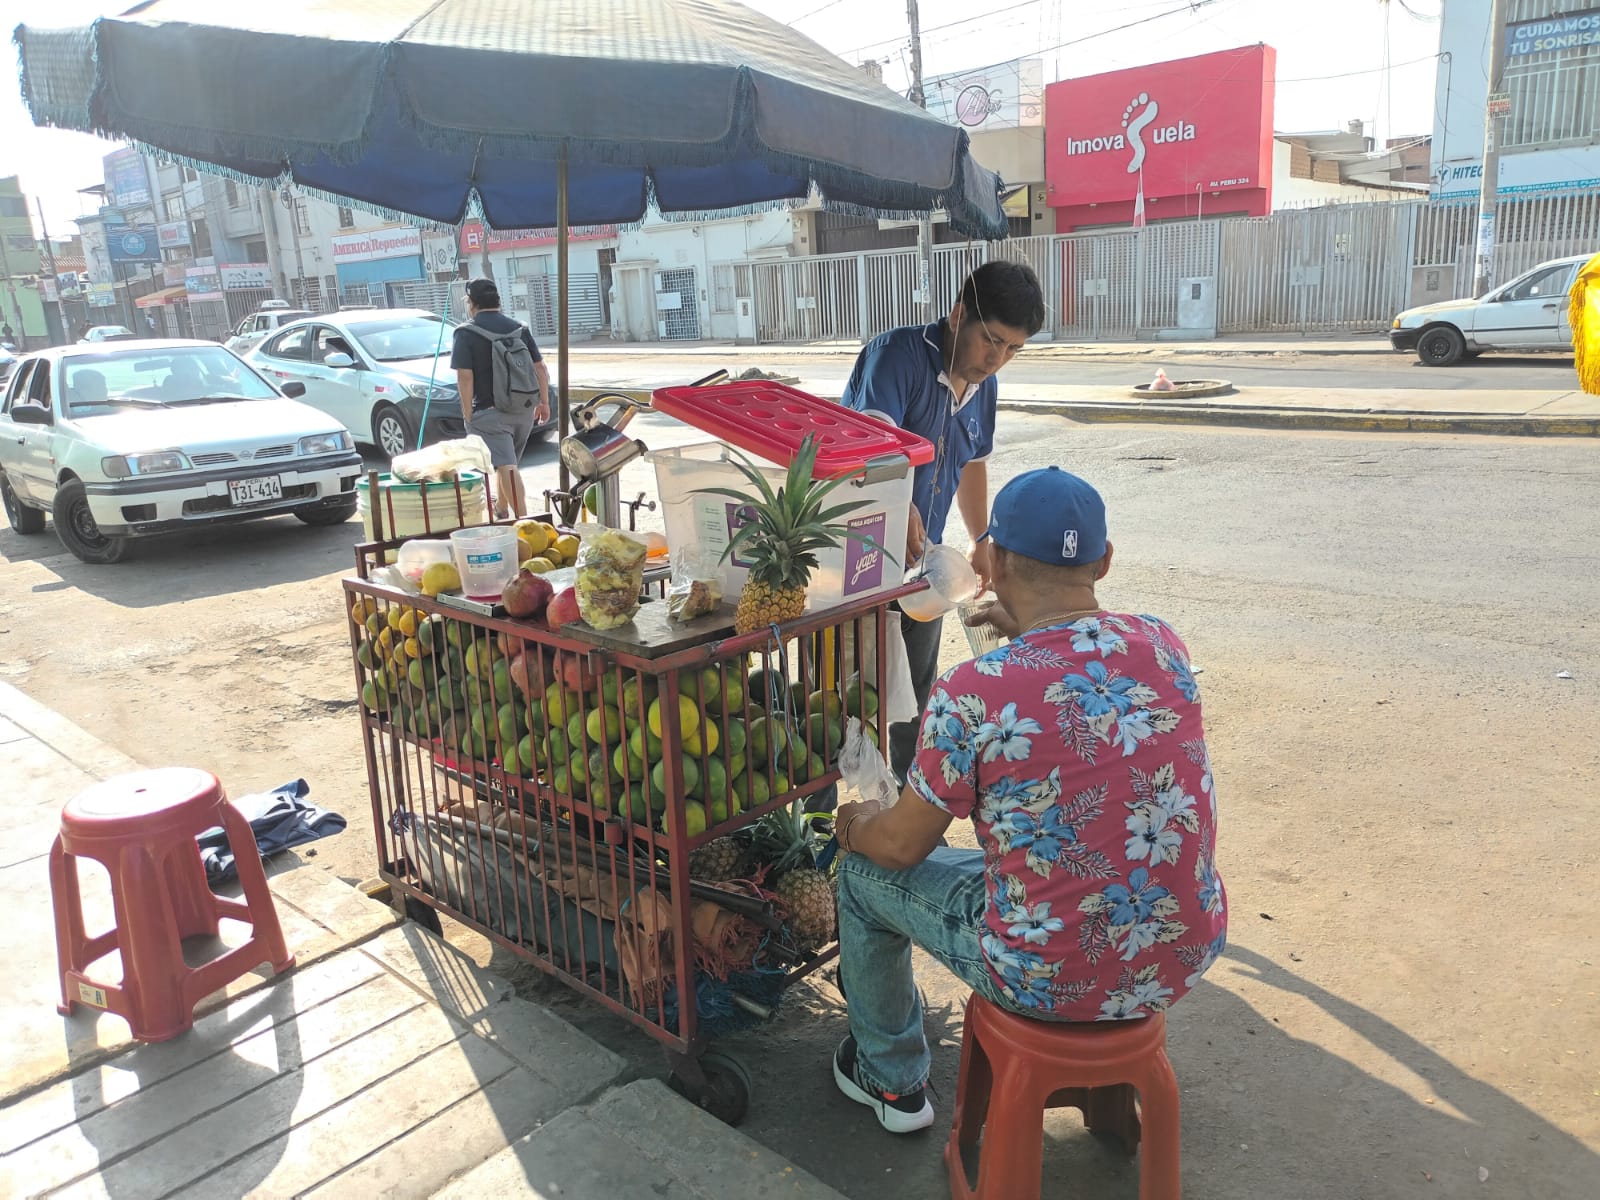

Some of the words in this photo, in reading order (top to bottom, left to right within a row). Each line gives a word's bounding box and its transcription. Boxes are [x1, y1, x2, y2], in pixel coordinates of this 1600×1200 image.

[1515, 15, 1600, 40] CUIDAMOS
[1510, 41, 1530, 55] TU
[1534, 31, 1600, 52] SONRISA
[1067, 134, 1125, 156] Innova
[333, 240, 371, 257] AMERICA
[371, 234, 420, 253] Repuestos
[850, 550, 879, 586] yape
